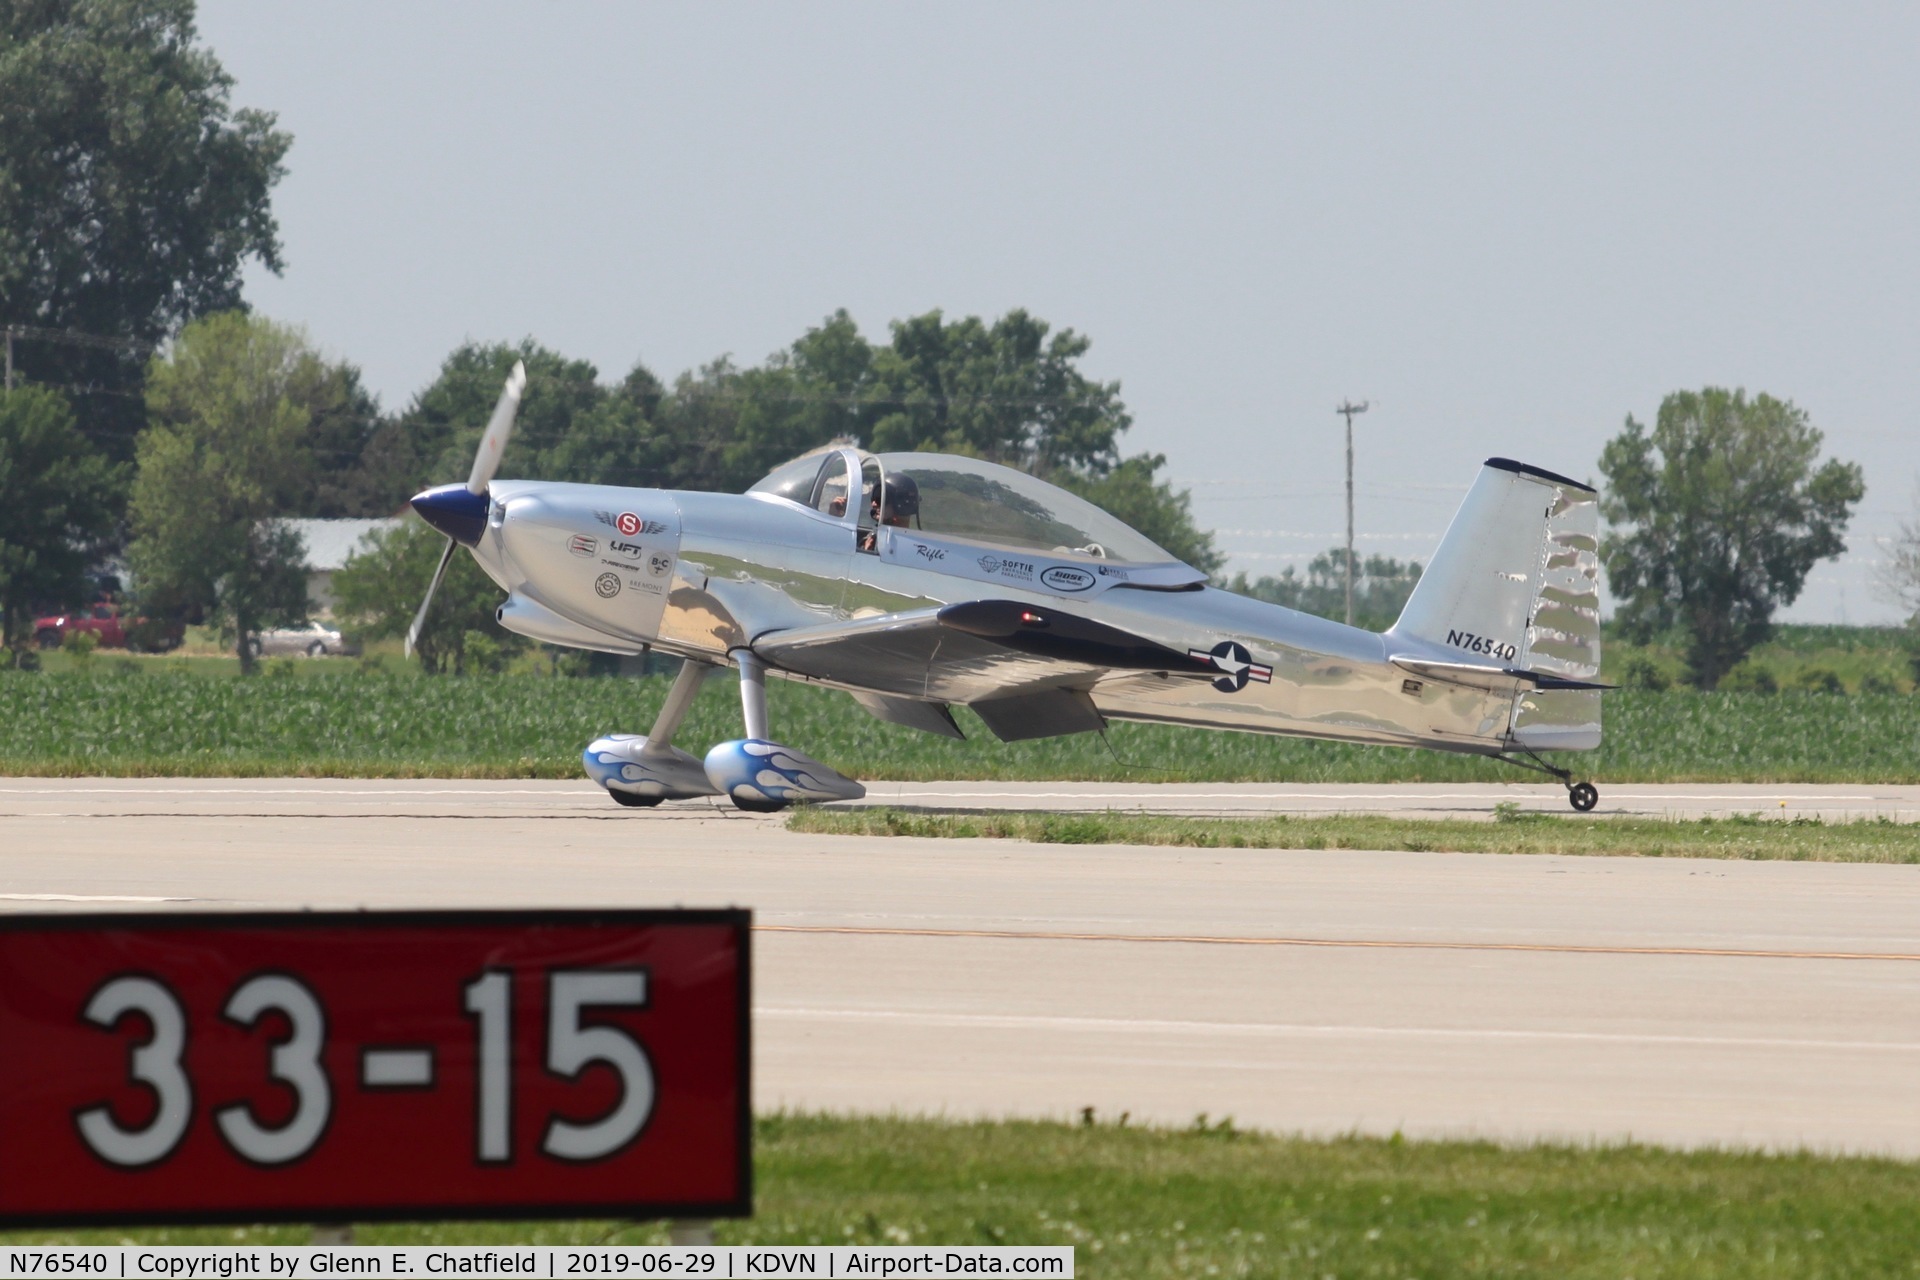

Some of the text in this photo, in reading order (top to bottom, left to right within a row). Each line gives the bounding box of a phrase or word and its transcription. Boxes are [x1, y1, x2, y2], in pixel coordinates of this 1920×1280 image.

[610, 541, 642, 555] LIFT
[1002, 559, 1034, 573] SOFTIE
[1054, 571, 1083, 581] BOSE
[629, 579, 663, 593] BREMONT
[1446, 629, 1516, 660] N76540
[78, 971, 655, 1165] 33-15
